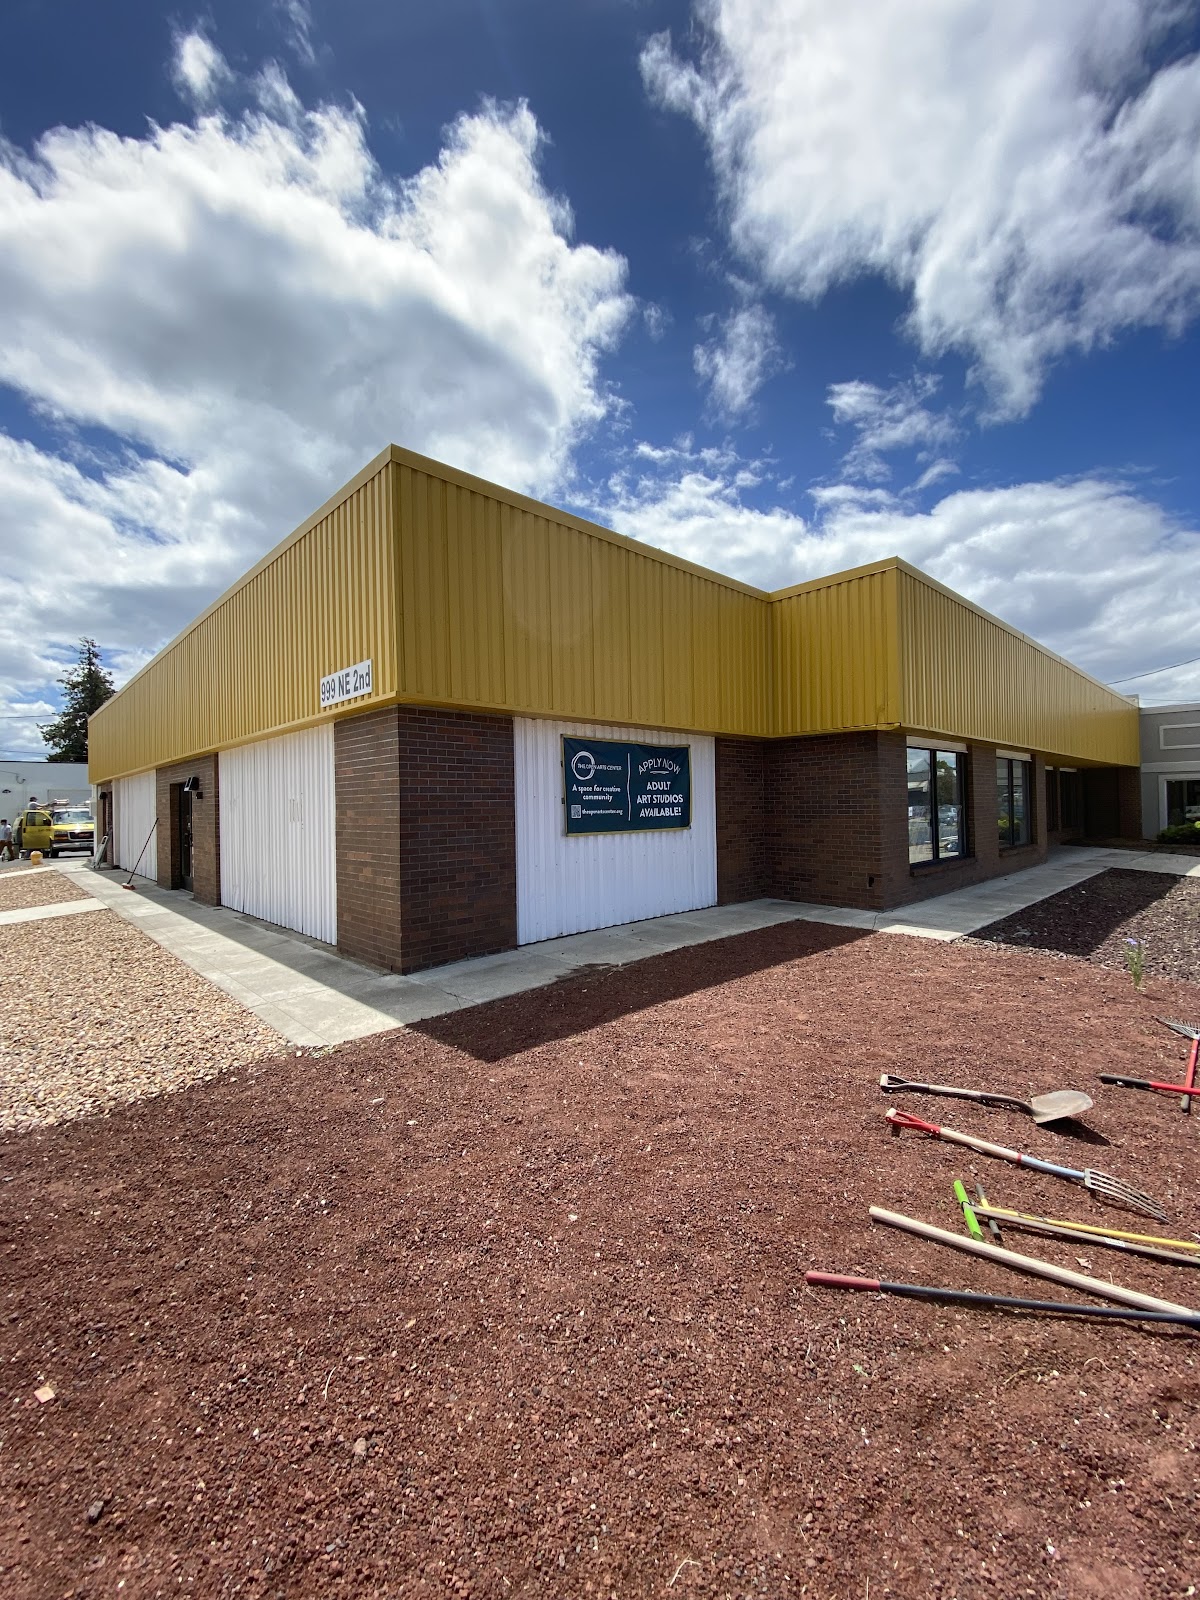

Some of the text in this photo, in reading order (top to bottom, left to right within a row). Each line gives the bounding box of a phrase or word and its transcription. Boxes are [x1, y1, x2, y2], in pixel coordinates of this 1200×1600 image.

[322, 664, 370, 702] 999 NE 2nd
[638, 758, 681, 775] APPLY NOW
[578, 786, 592, 794] space
[593, 784, 602, 792] for
[647, 781, 671, 790] ADULT
[583, 793, 613, 802] community
[637, 794, 684, 804] ART STUDIOS
[640, 807, 682, 817] AVAILABLE!
